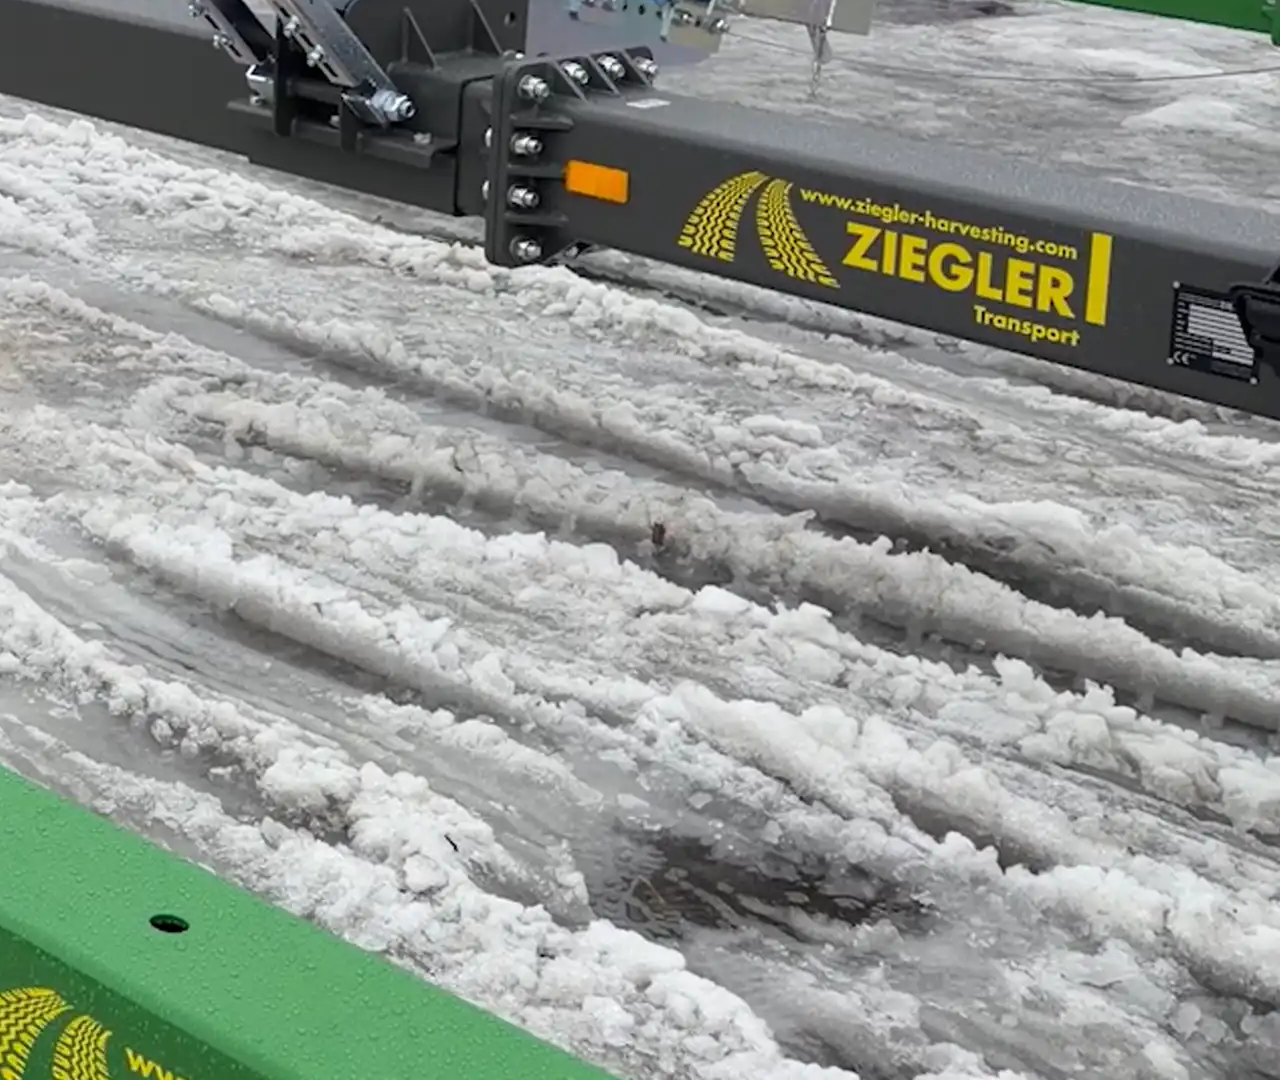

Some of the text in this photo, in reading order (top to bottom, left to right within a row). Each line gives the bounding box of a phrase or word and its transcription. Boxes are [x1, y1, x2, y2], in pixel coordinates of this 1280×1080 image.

[799, 187, 1079, 261] www.ziegler-harvesting.com
[841, 221, 1076, 320] ZIEGLER
[972, 304, 1081, 348] Transport
